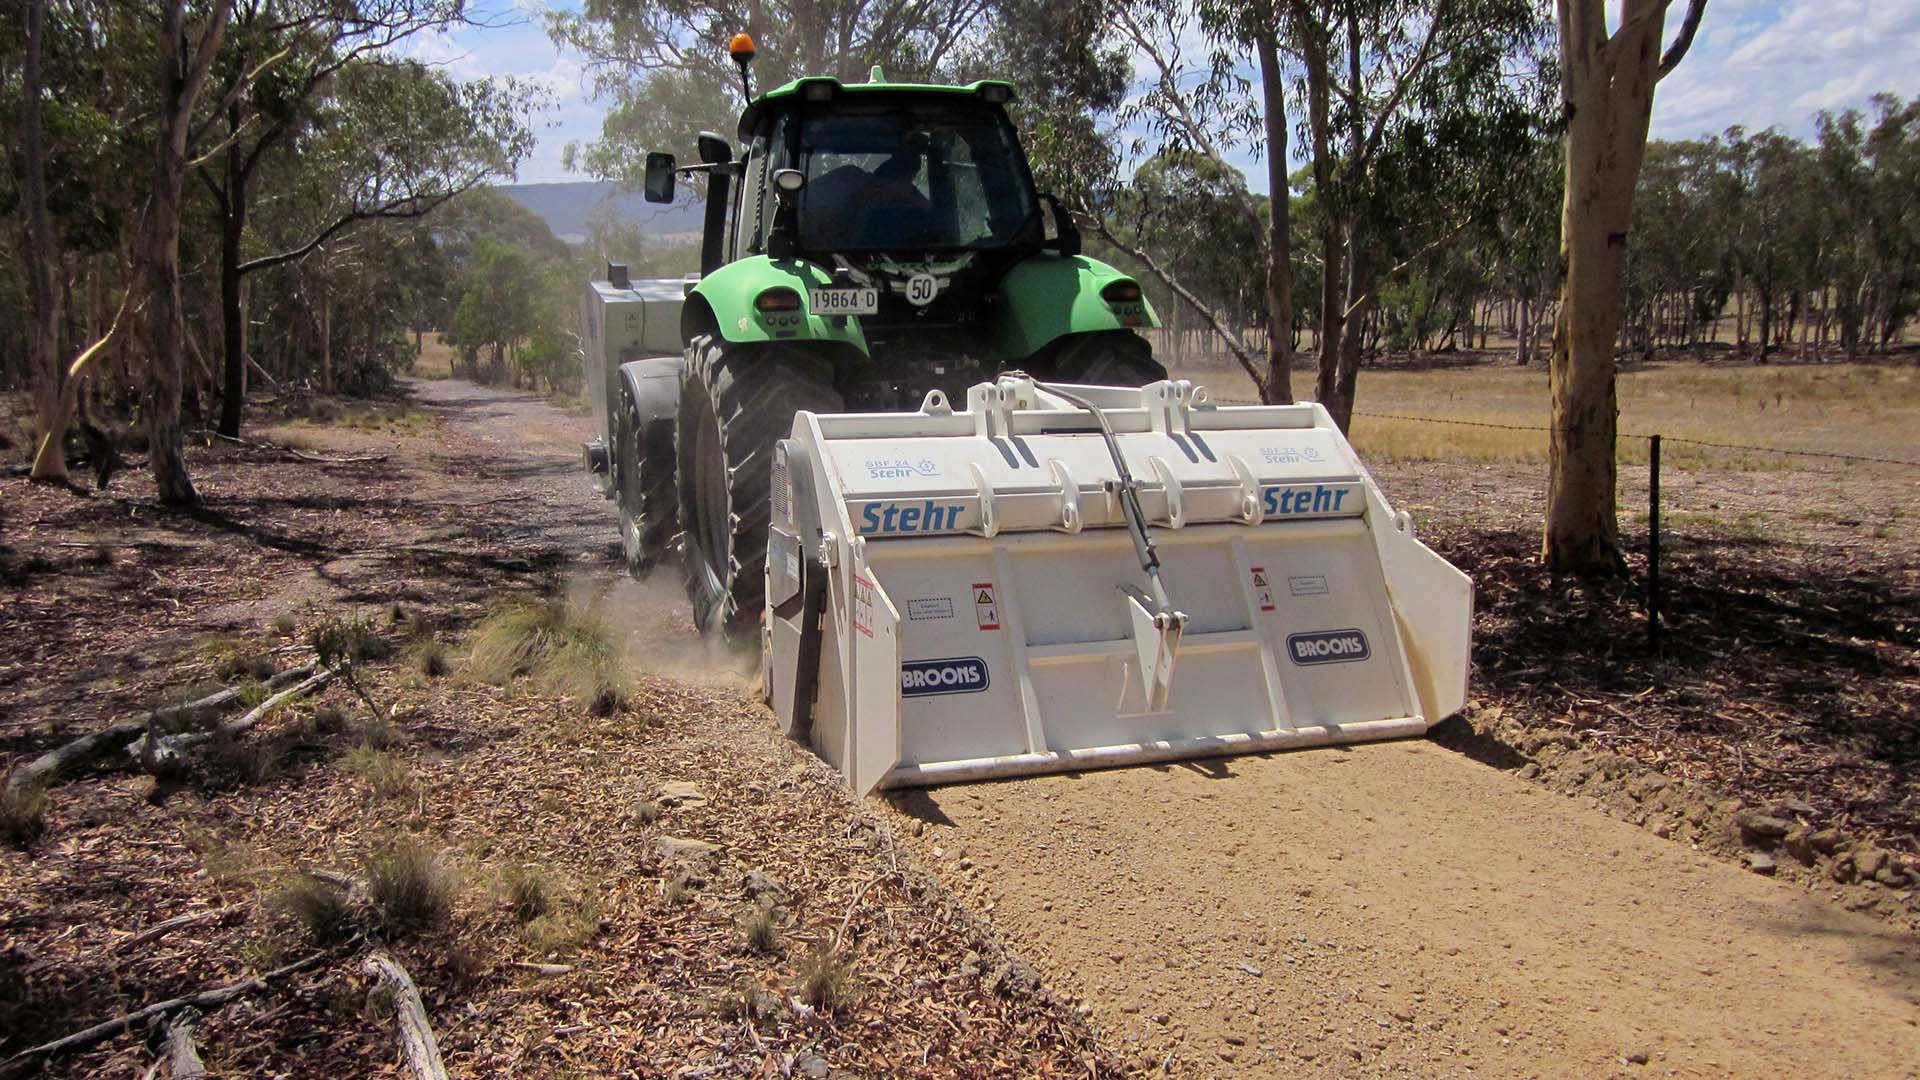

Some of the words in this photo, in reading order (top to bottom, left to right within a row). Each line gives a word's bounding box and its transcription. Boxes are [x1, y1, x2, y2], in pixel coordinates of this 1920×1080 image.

[912, 279, 931, 300] 50
[870, 468, 913, 479] Stehr
[1263, 485, 1349, 515] Stehr
[860, 501, 965, 533] Stehr
[1296, 637, 1363, 658] BROONS
[902, 666, 981, 688] BROONS
